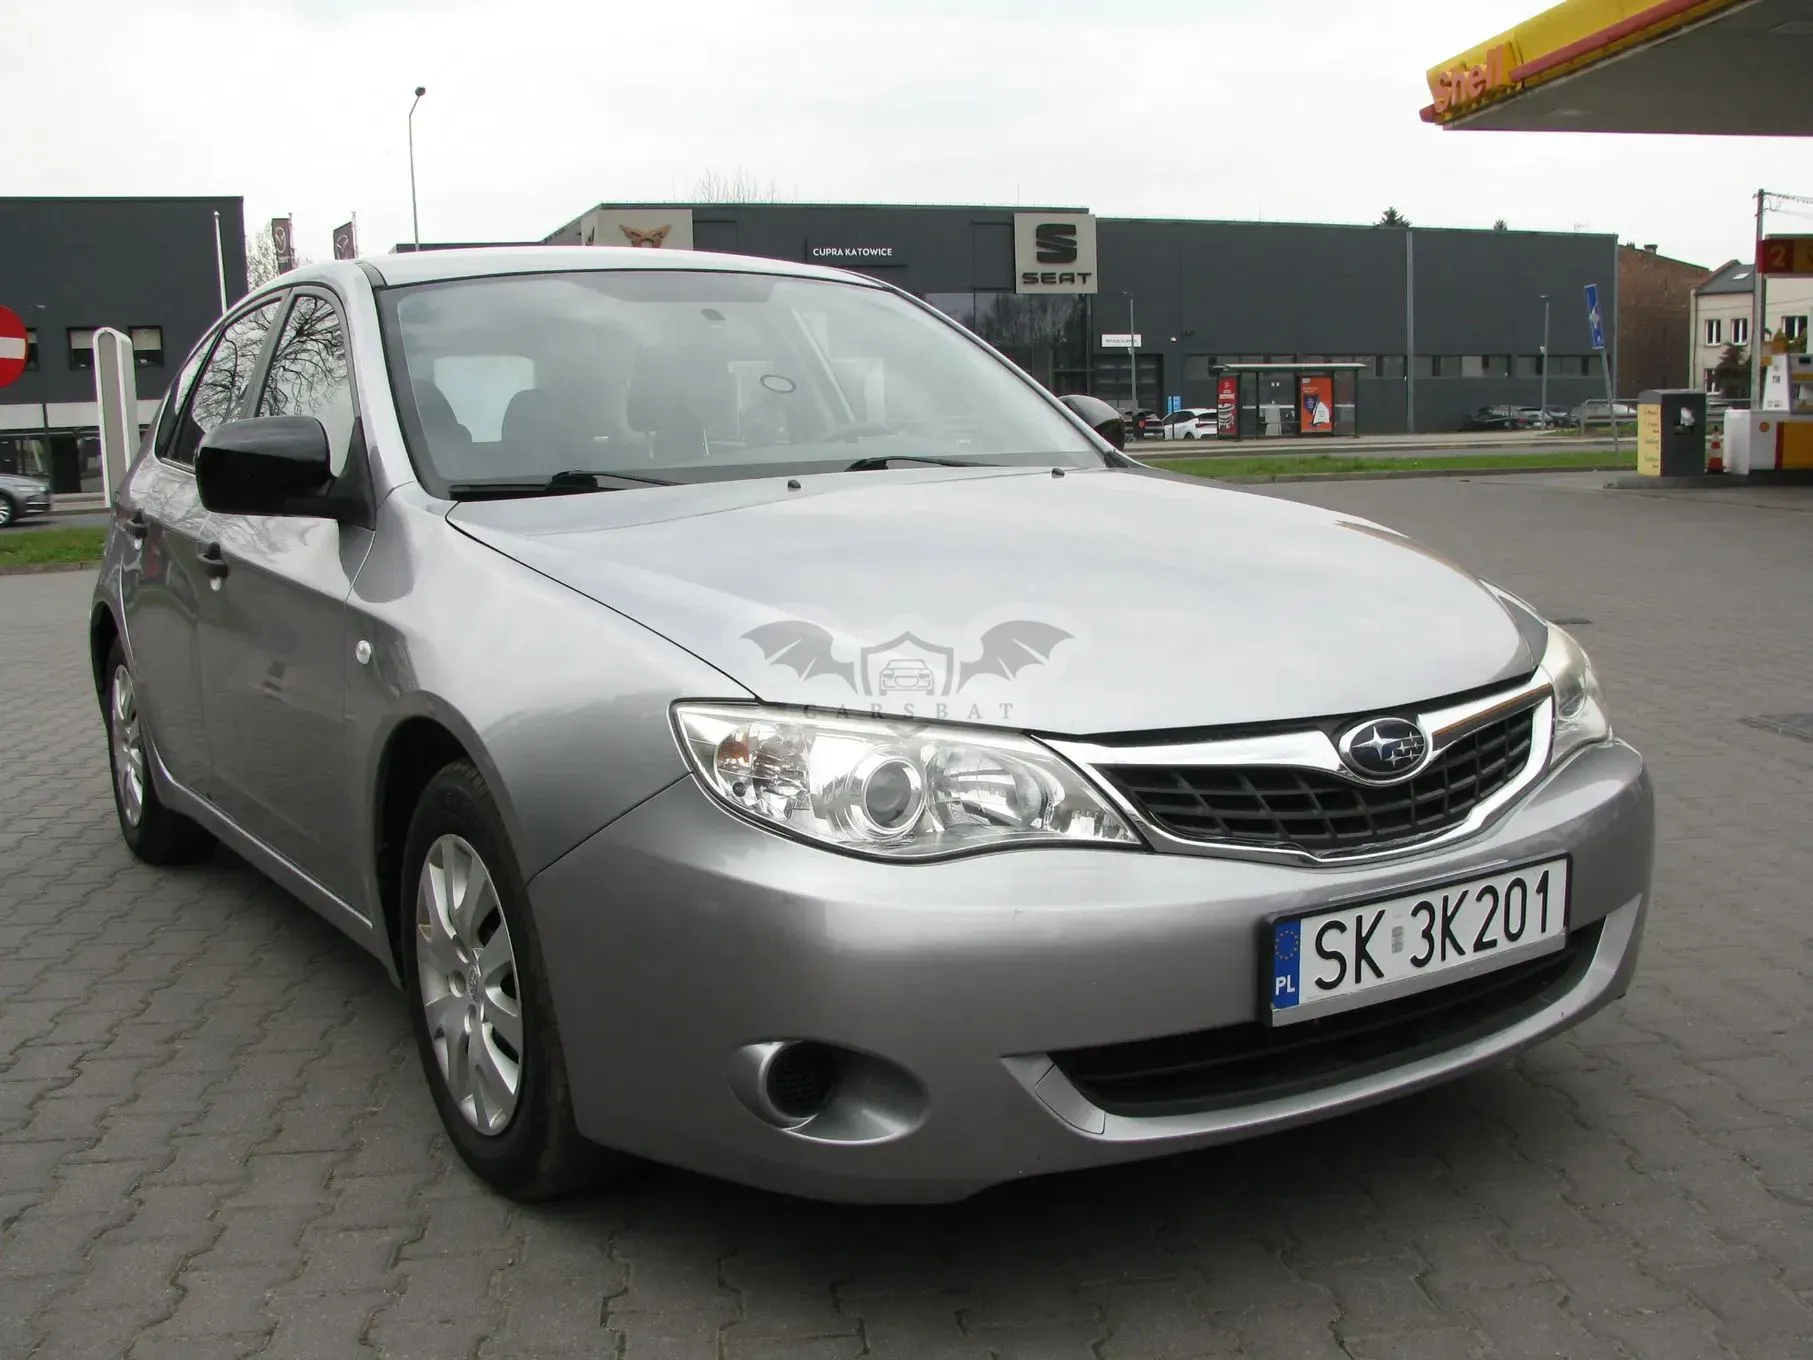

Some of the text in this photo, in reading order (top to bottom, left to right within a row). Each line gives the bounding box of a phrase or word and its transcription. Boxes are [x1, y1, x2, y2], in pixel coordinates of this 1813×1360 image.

[1433, 43, 1504, 113] Shell
[812, 247, 893, 256] CUPRA KATOWICE
[1769, 244, 1787, 268] 2
[1022, 271, 1092, 285] SEAT
[1313, 870, 1551, 991] SK 3K201
[1275, 977, 1296, 996] PL
